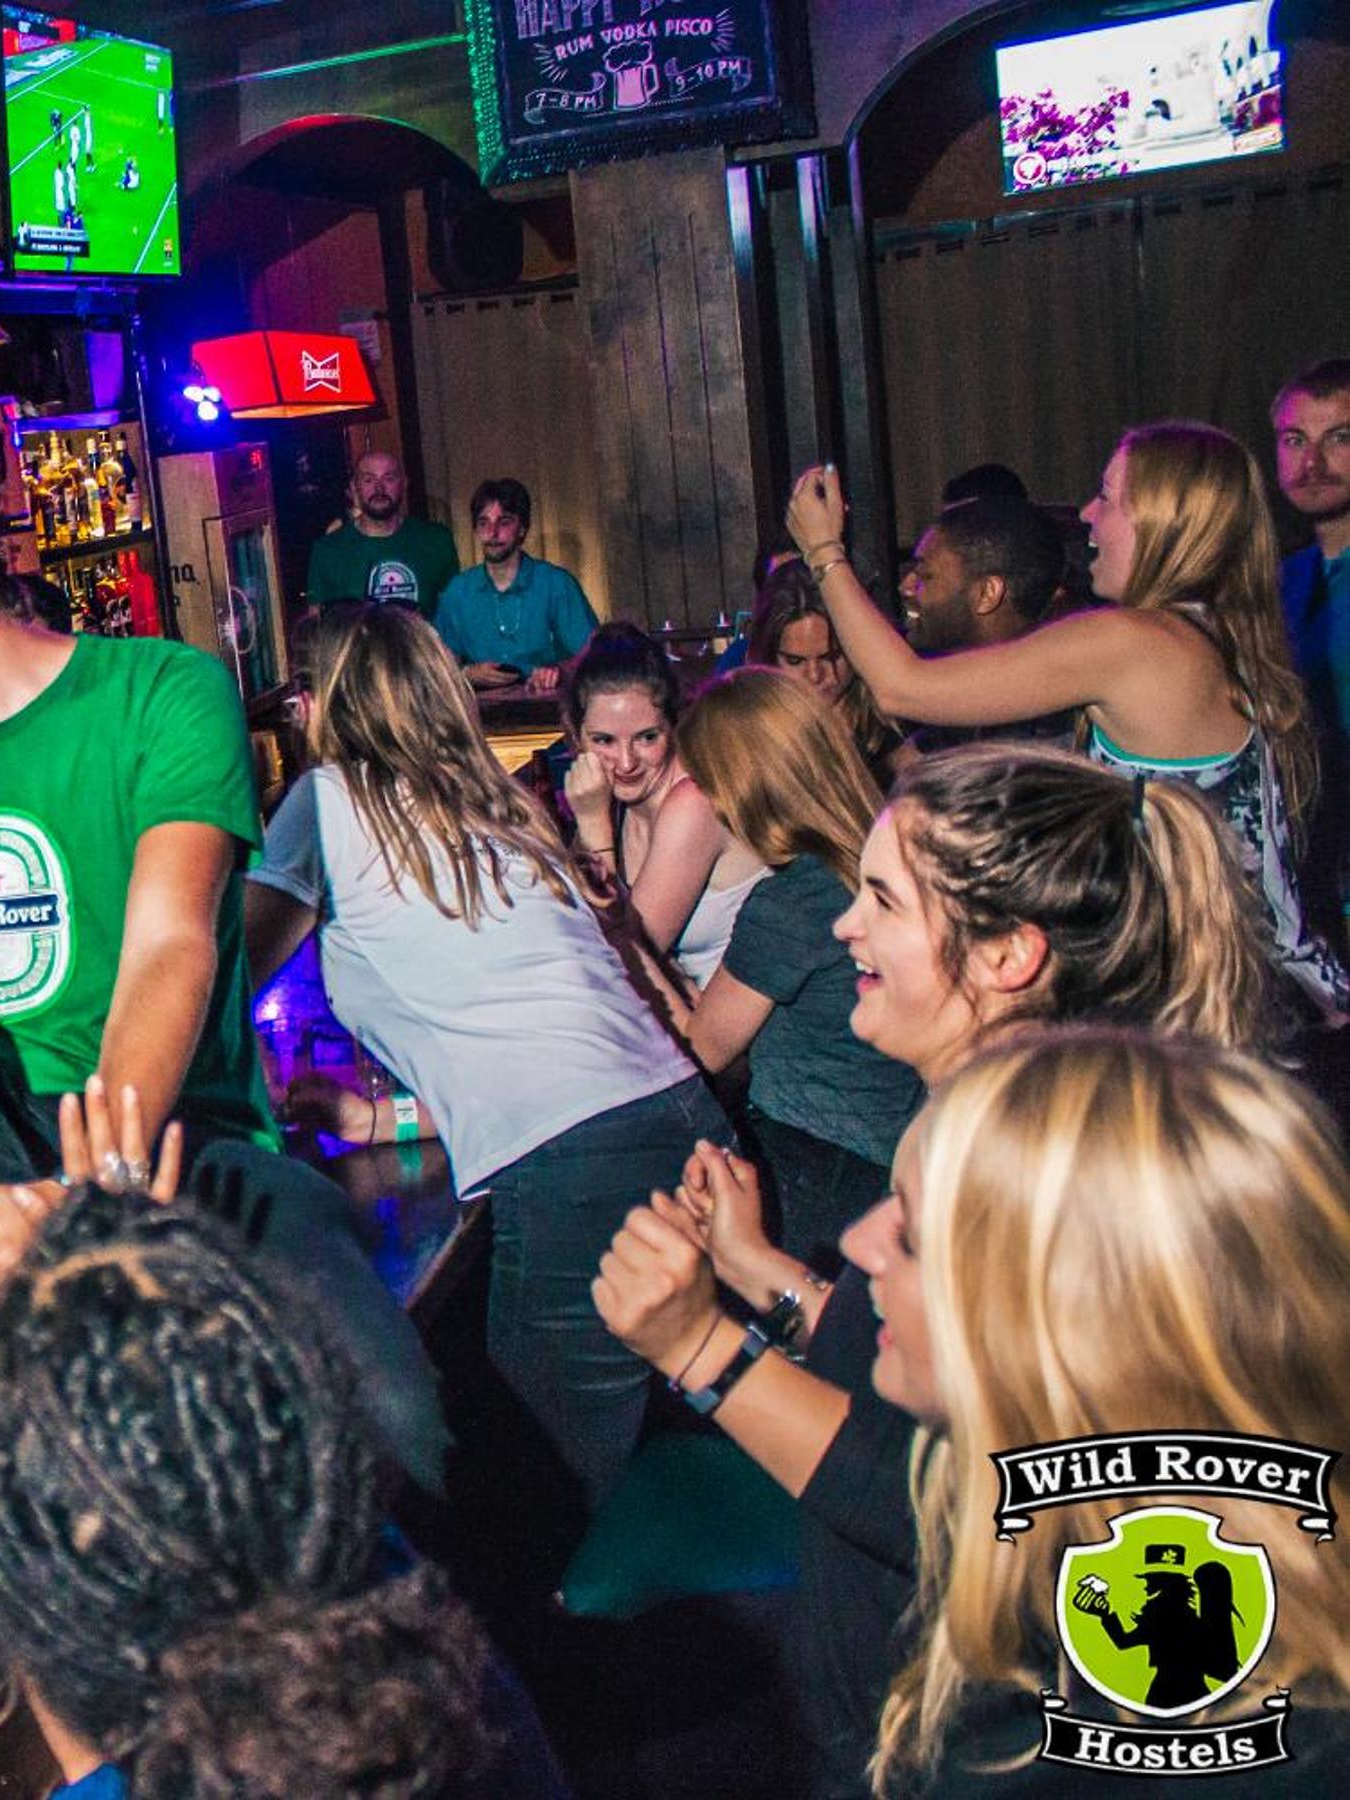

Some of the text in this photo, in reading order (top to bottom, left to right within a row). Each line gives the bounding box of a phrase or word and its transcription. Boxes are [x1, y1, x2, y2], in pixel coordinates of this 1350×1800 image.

[554, 18, 713, 60] RUM VODKA PISCO
[717, 60, 742, 78] PM
[574, 95, 597, 109] PM
